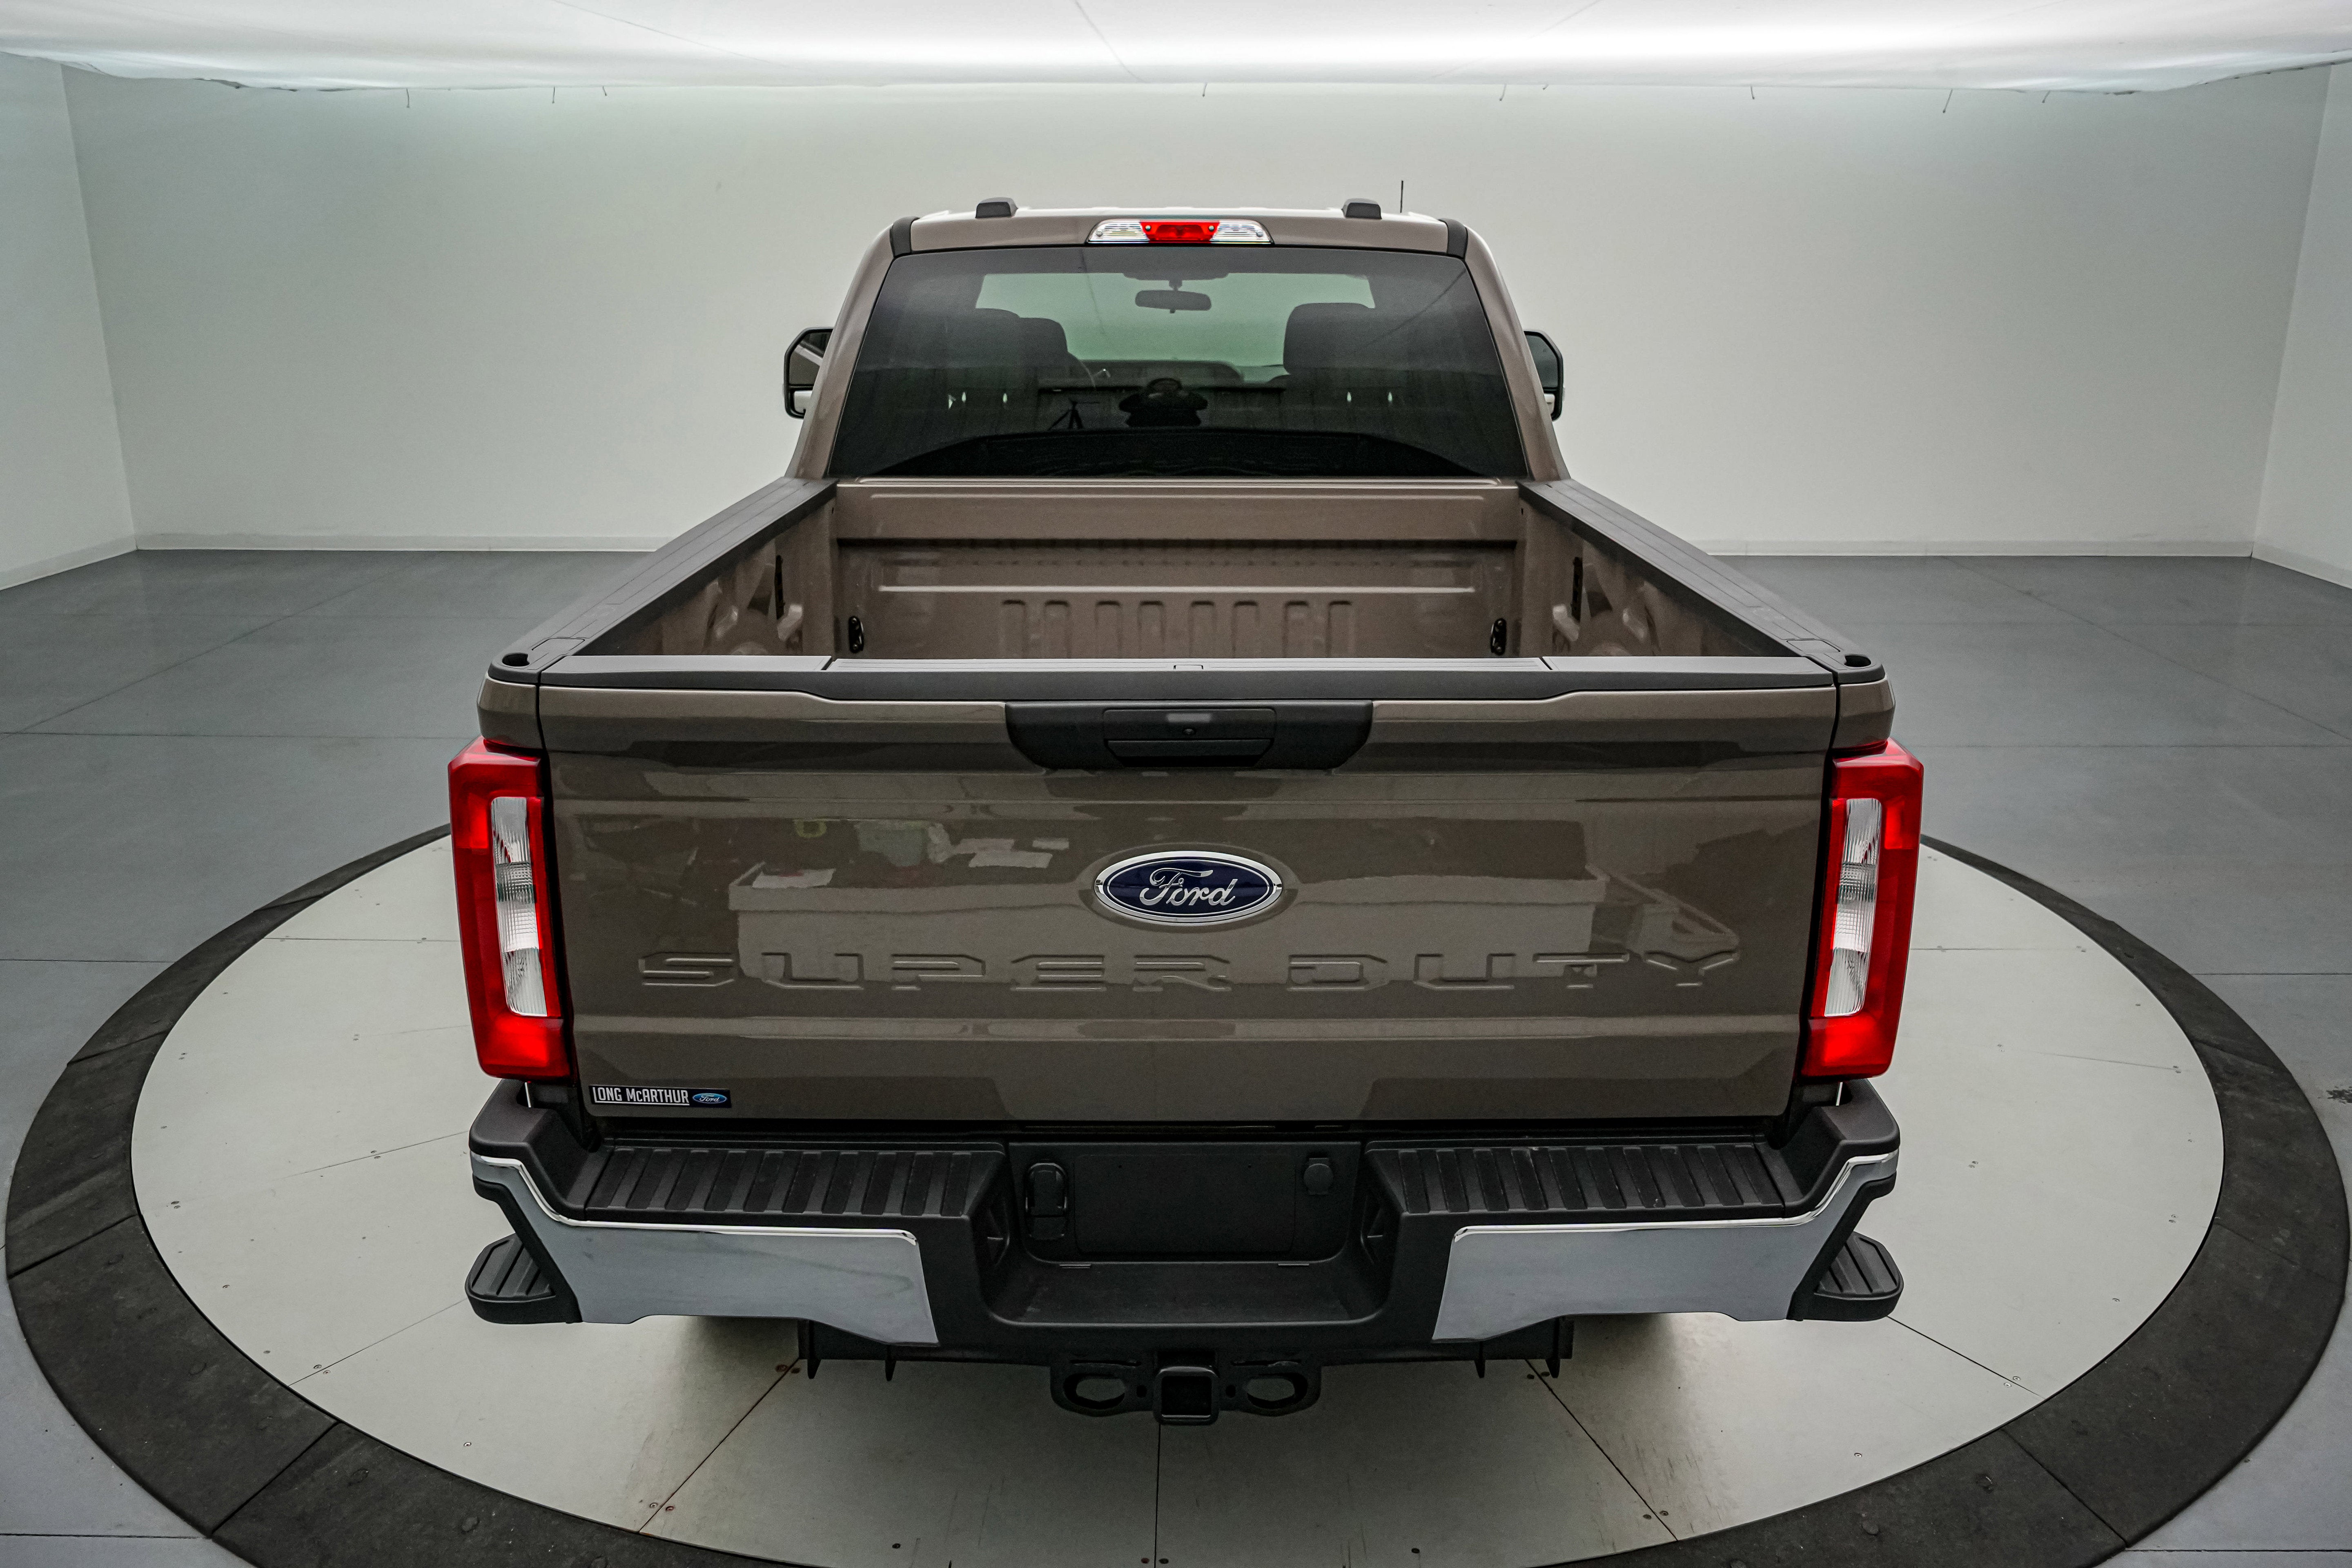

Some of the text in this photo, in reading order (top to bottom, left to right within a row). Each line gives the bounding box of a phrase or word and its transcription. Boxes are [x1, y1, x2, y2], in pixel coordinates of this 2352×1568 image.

[1139, 868, 1238, 906] Ford
[639, 951, 1739, 991] SUPER DUTY
[592, 1087, 720, 1103] LONG McARTHUR Ford
